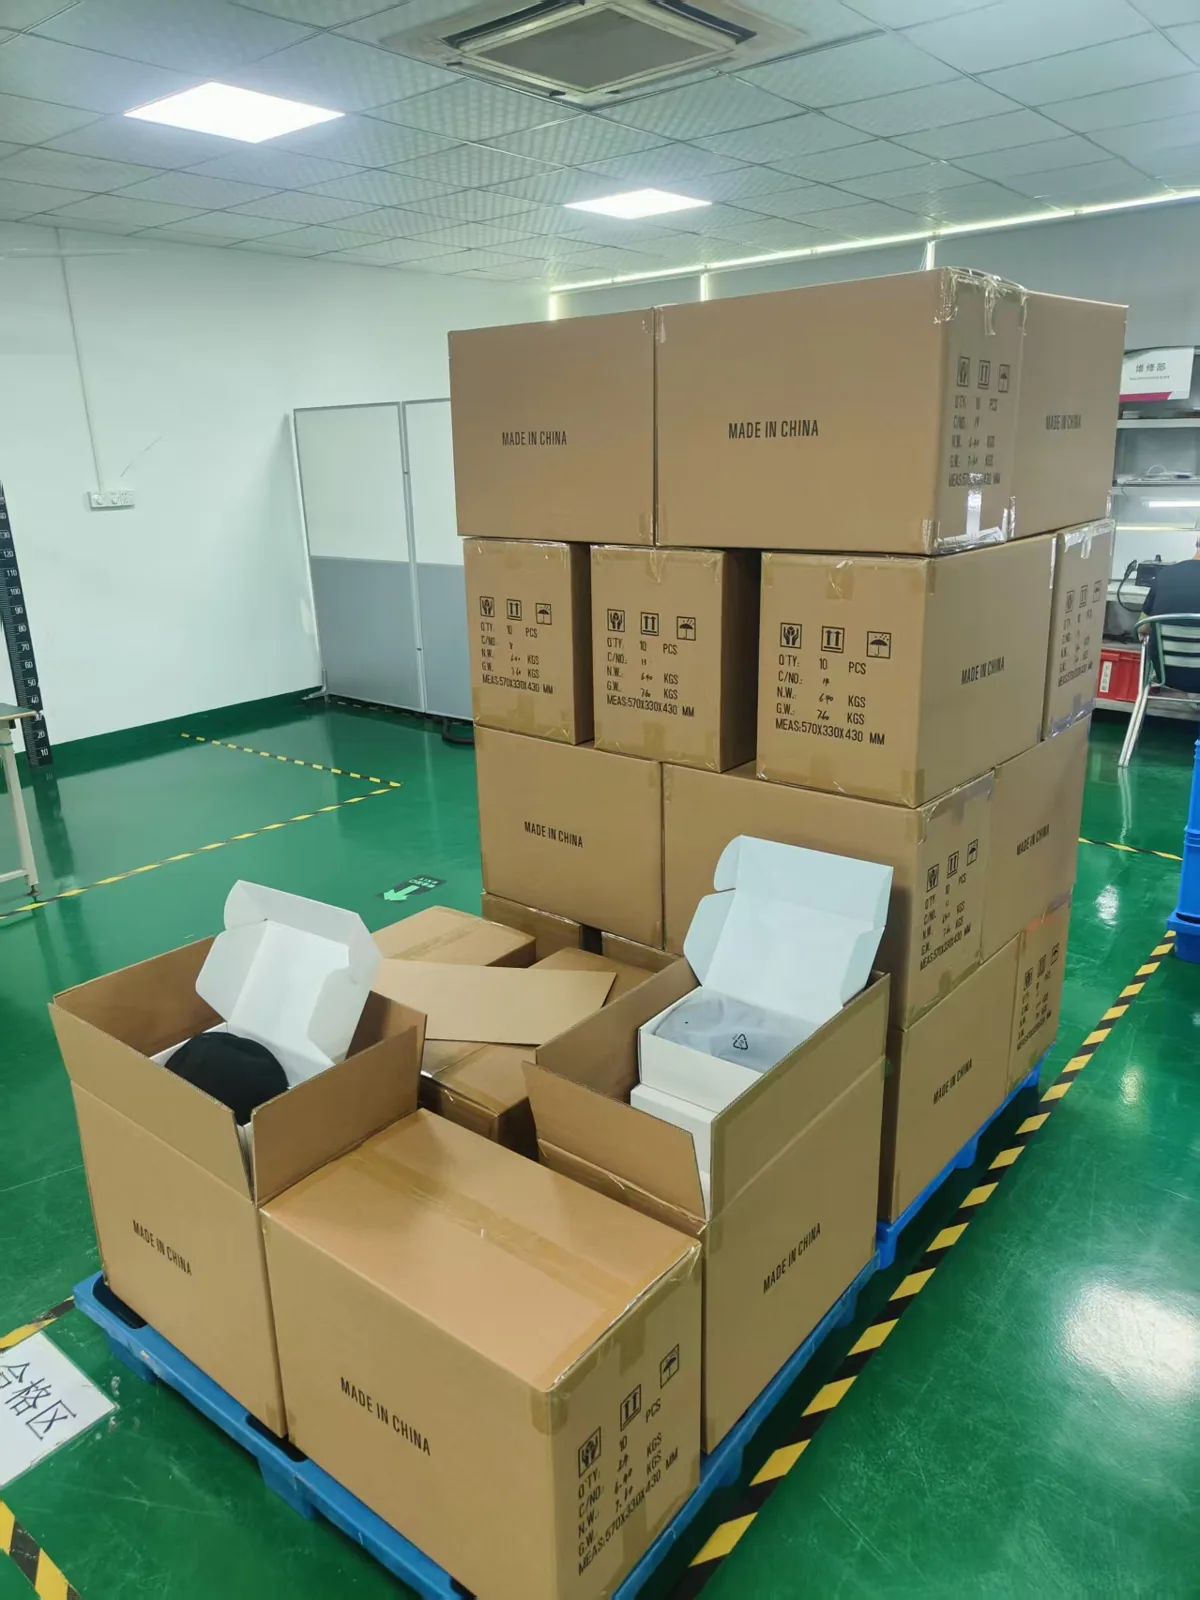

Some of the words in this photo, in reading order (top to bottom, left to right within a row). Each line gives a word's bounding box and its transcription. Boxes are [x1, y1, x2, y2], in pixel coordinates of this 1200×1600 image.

[502, 431, 526, 446] MADE
[528, 431, 537, 446] IN
[540, 430, 567, 445] CHINA
[729, 422, 761, 440] MADE
[765, 421, 777, 438] IN
[780, 420, 818, 437] CHINA
[10, 588, 20, 596] 100
[14, 606, 23, 614] 90
[506, 624, 513, 635] 10
[525, 627, 538, 638] PCS
[21, 643, 30, 651] 70
[640, 640, 647, 652] 10
[662, 643, 678, 655] PCS
[527, 654, 540, 665] KGS
[819, 658, 828, 670] 10
[848, 661, 867, 674] PCS
[528, 668, 540, 678] KGS
[962, 665, 979, 684] MADE
[980, 662, 987, 678] IN
[988, 656, 1004, 675] CHINA
[28, 678, 36, 686] 50
[664, 672, 678, 685] KGS
[542, 684, 554, 694] MM
[664, 688, 678, 700] KGS
[31, 696, 39, 704] 40
[606, 694, 678, 715] MEAS:570X330X430
[682, 706, 694, 717] MM
[848, 694, 866, 708] KGS
[846, 712, 865, 725] KGS
[776, 718, 864, 742] MEAS:570X330X430
[869, 732, 885, 745] MM
[41, 748, 48, 756] 10
[524, 820, 546, 838] MADE
[548, 827, 556, 840] IN
[558, 830, 584, 848] CHINA
[933, 1080, 950, 1105] MADE
[950, 1074, 956, 1088] IN
[957, 1058, 972, 1082] CHINA
[132, 1220, 154, 1248] MADE
[156, 1238, 164, 1256] IN
[166, 1246, 192, 1276] CHINA
[764, 1258, 786, 1294] MADE
[788, 1247, 796, 1267] IN
[798, 1222, 820, 1256] CHINA
[0, 1362, 76, 1440] 合格区
[340, 1376, 373, 1413] MADE
[376, 1402, 388, 1425] IN
[392, 1414, 430, 1456] CHINA
[619, 1436, 628, 1452] 10
[645, 1398, 661, 1423] PCS
[646, 1432, 662, 1458] KGS
[646, 1450, 662, 1476] KGS
[578, 1470, 661, 1576] MEAS:570X330X430
[664, 1446, 679, 1472] MM
